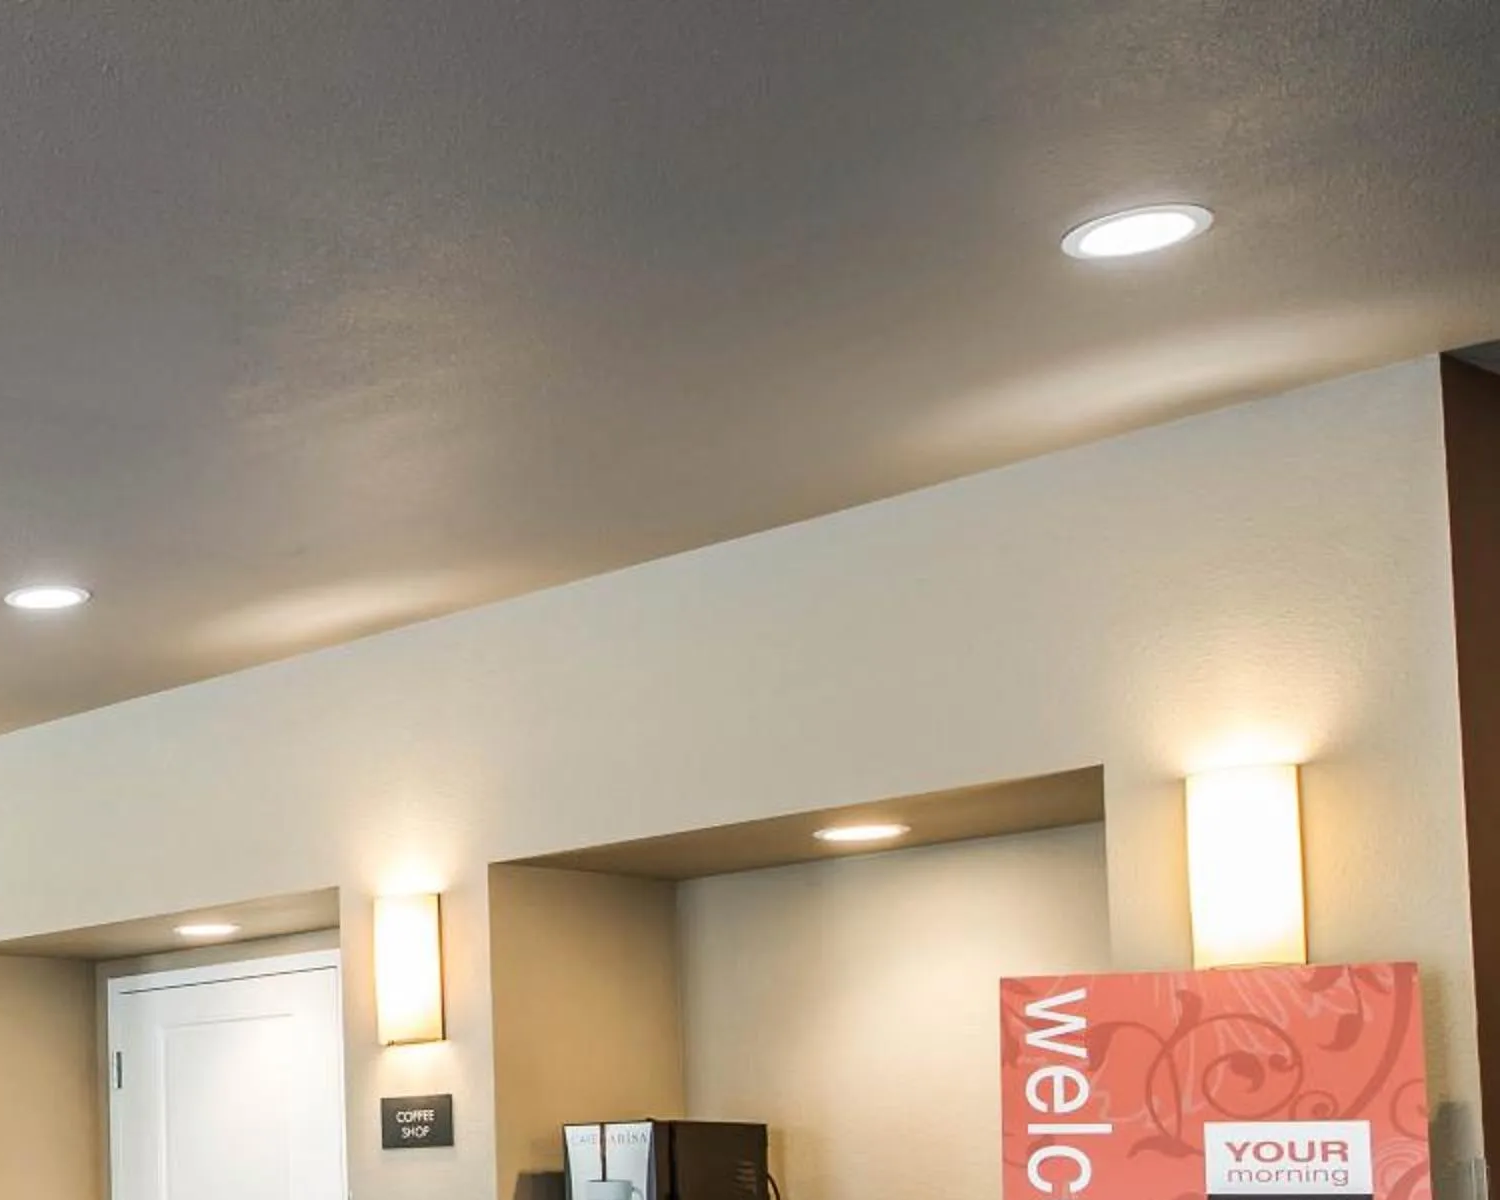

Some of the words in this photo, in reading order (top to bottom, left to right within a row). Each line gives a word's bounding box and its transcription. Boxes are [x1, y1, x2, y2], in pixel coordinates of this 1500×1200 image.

[395, 1109, 435, 1123] COFFEE
[401, 1125, 431, 1139] SHOP
[1225, 1140, 1349, 1163] YOUR
[1227, 1165, 1349, 1187] morning
